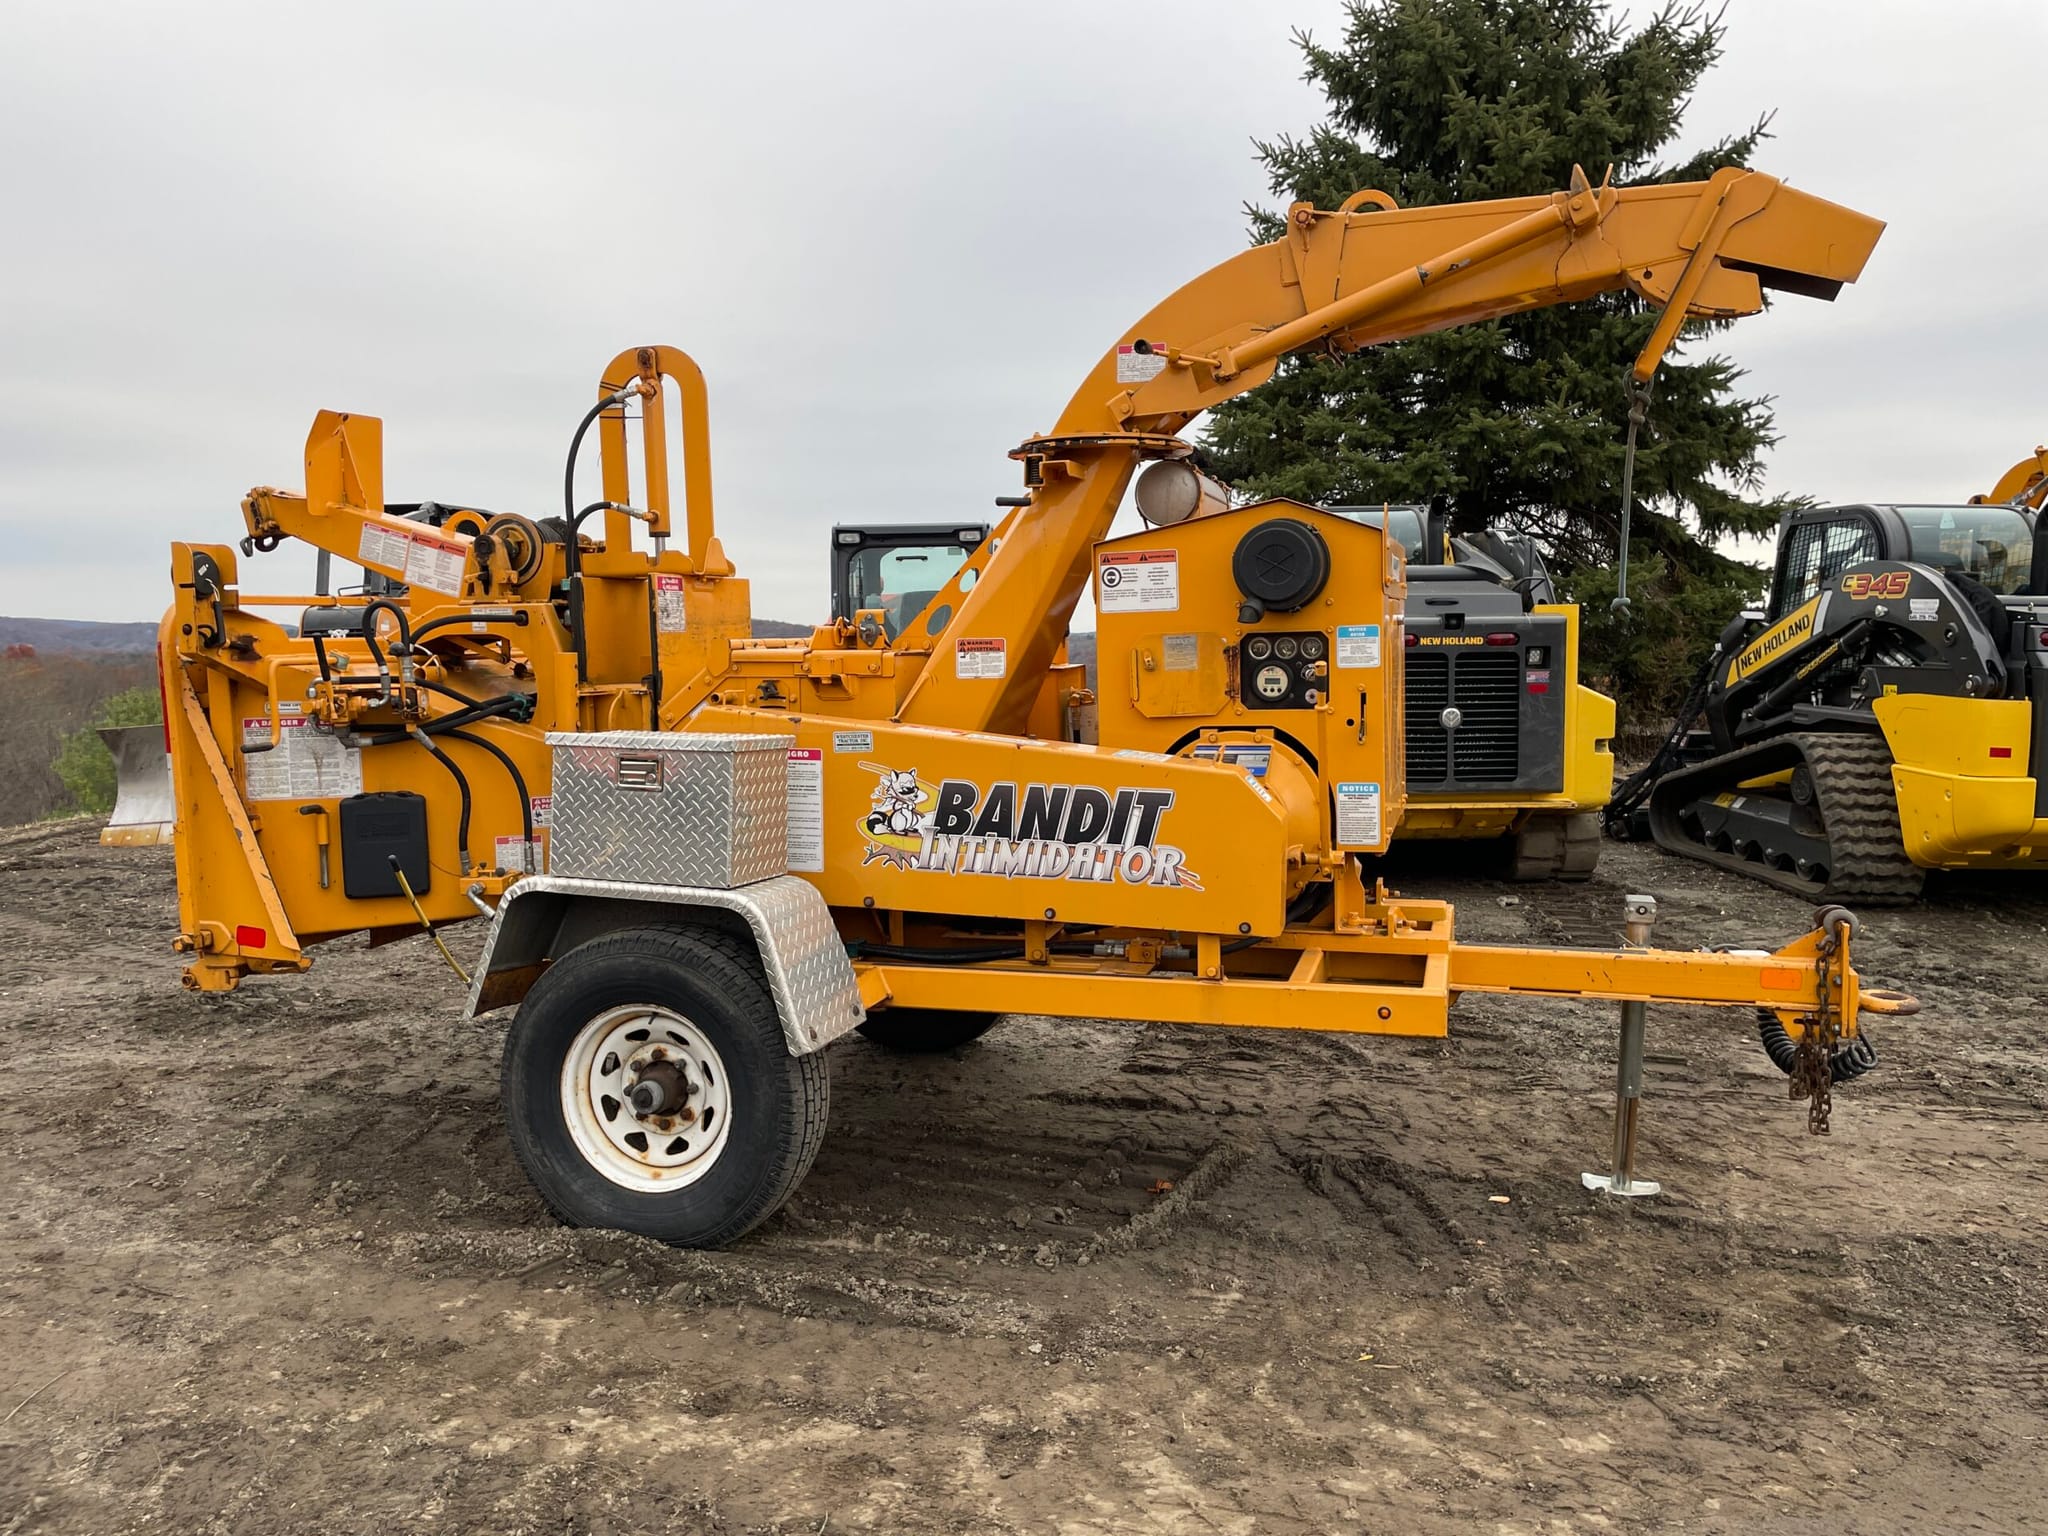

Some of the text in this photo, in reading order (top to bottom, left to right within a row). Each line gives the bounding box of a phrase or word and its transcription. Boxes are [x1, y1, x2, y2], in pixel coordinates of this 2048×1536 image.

[1842, 572, 1910, 599] C345
[1420, 636, 1484, 646] NEW HOLLAND
[1740, 645, 1762, 671] NEW
[1764, 614, 1810, 656] HOLLAND
[933, 779, 1175, 848] BANDIT
[914, 826, 1184, 887] INTIMIDATOR
